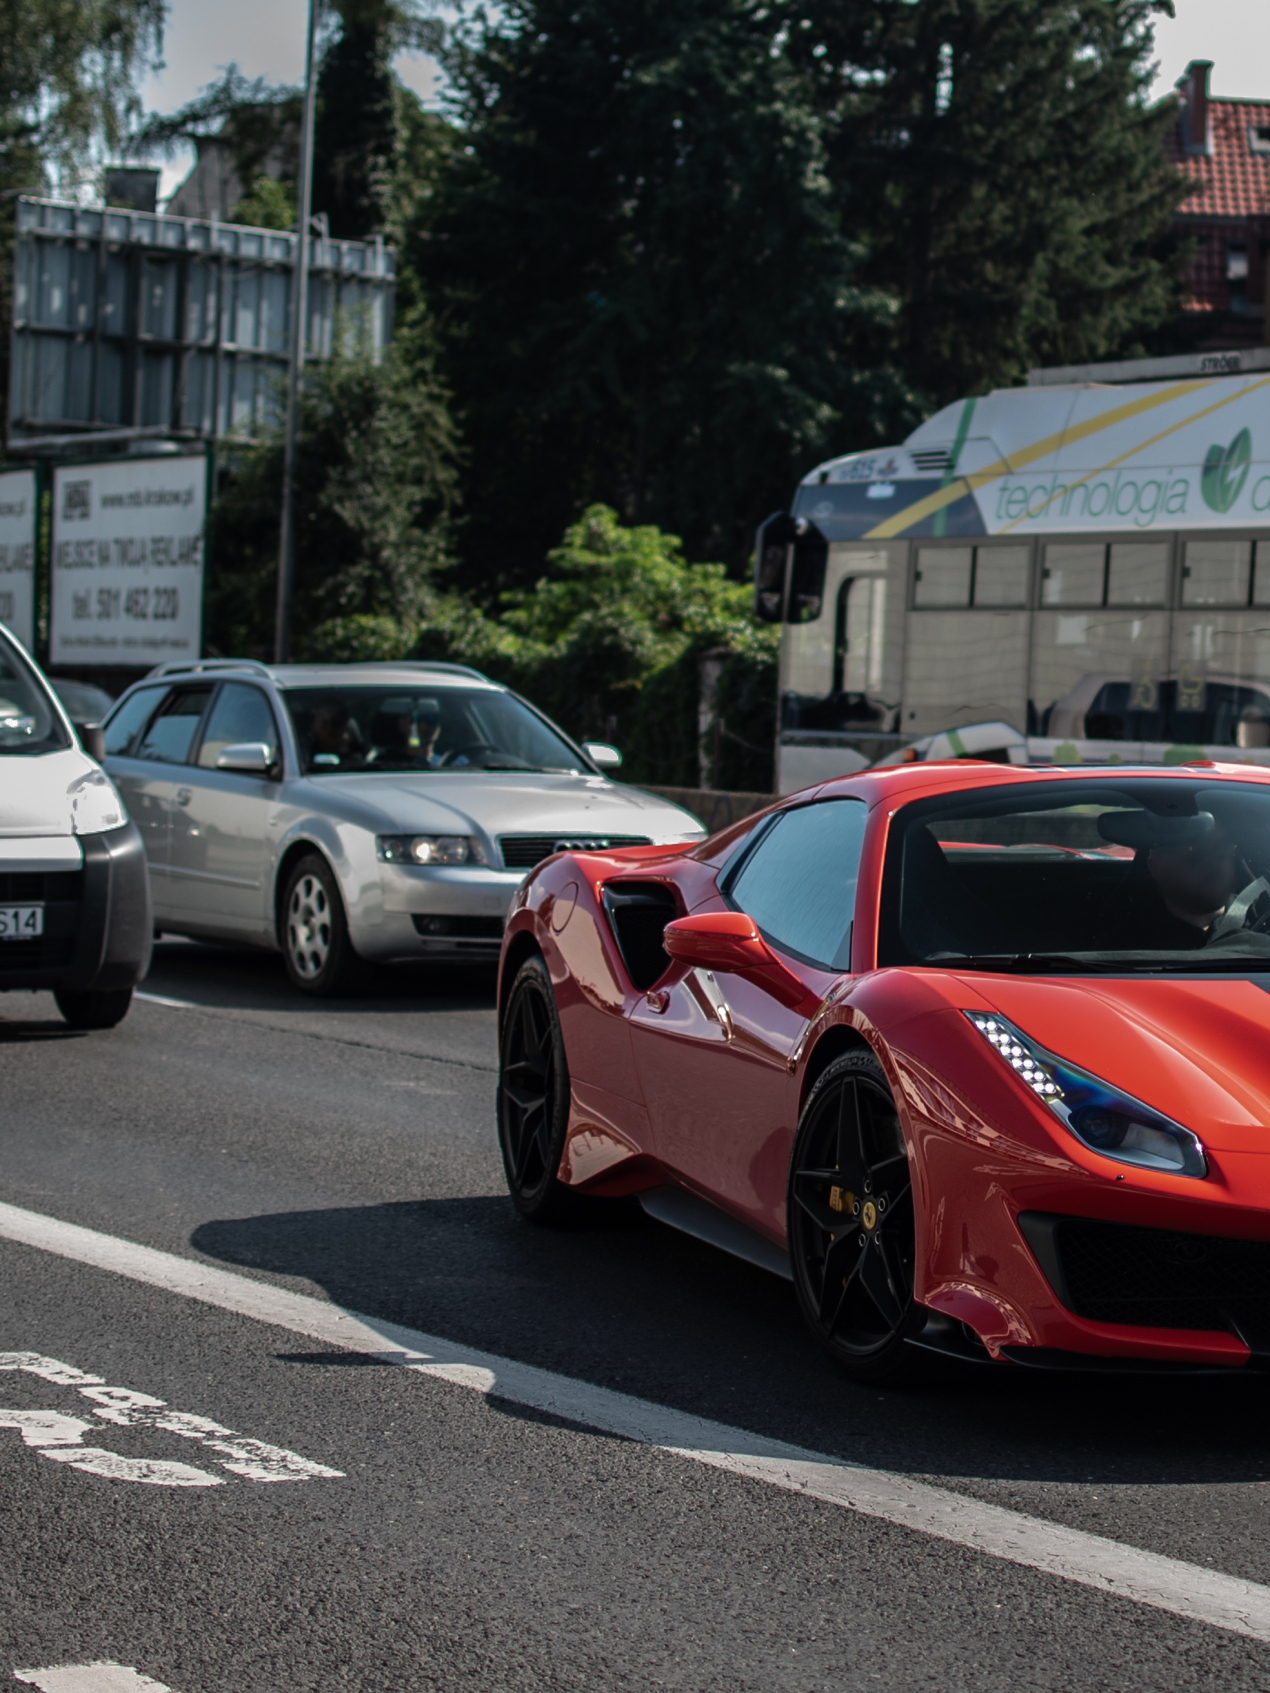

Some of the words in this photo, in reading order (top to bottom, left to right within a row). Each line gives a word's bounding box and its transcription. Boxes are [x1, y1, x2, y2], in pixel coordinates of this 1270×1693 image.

[995, 468, 1190, 528] technologia
[96, 587, 121, 620] 501
[124, 586, 150, 620] 462
[153, 586, 180, 620] 220
